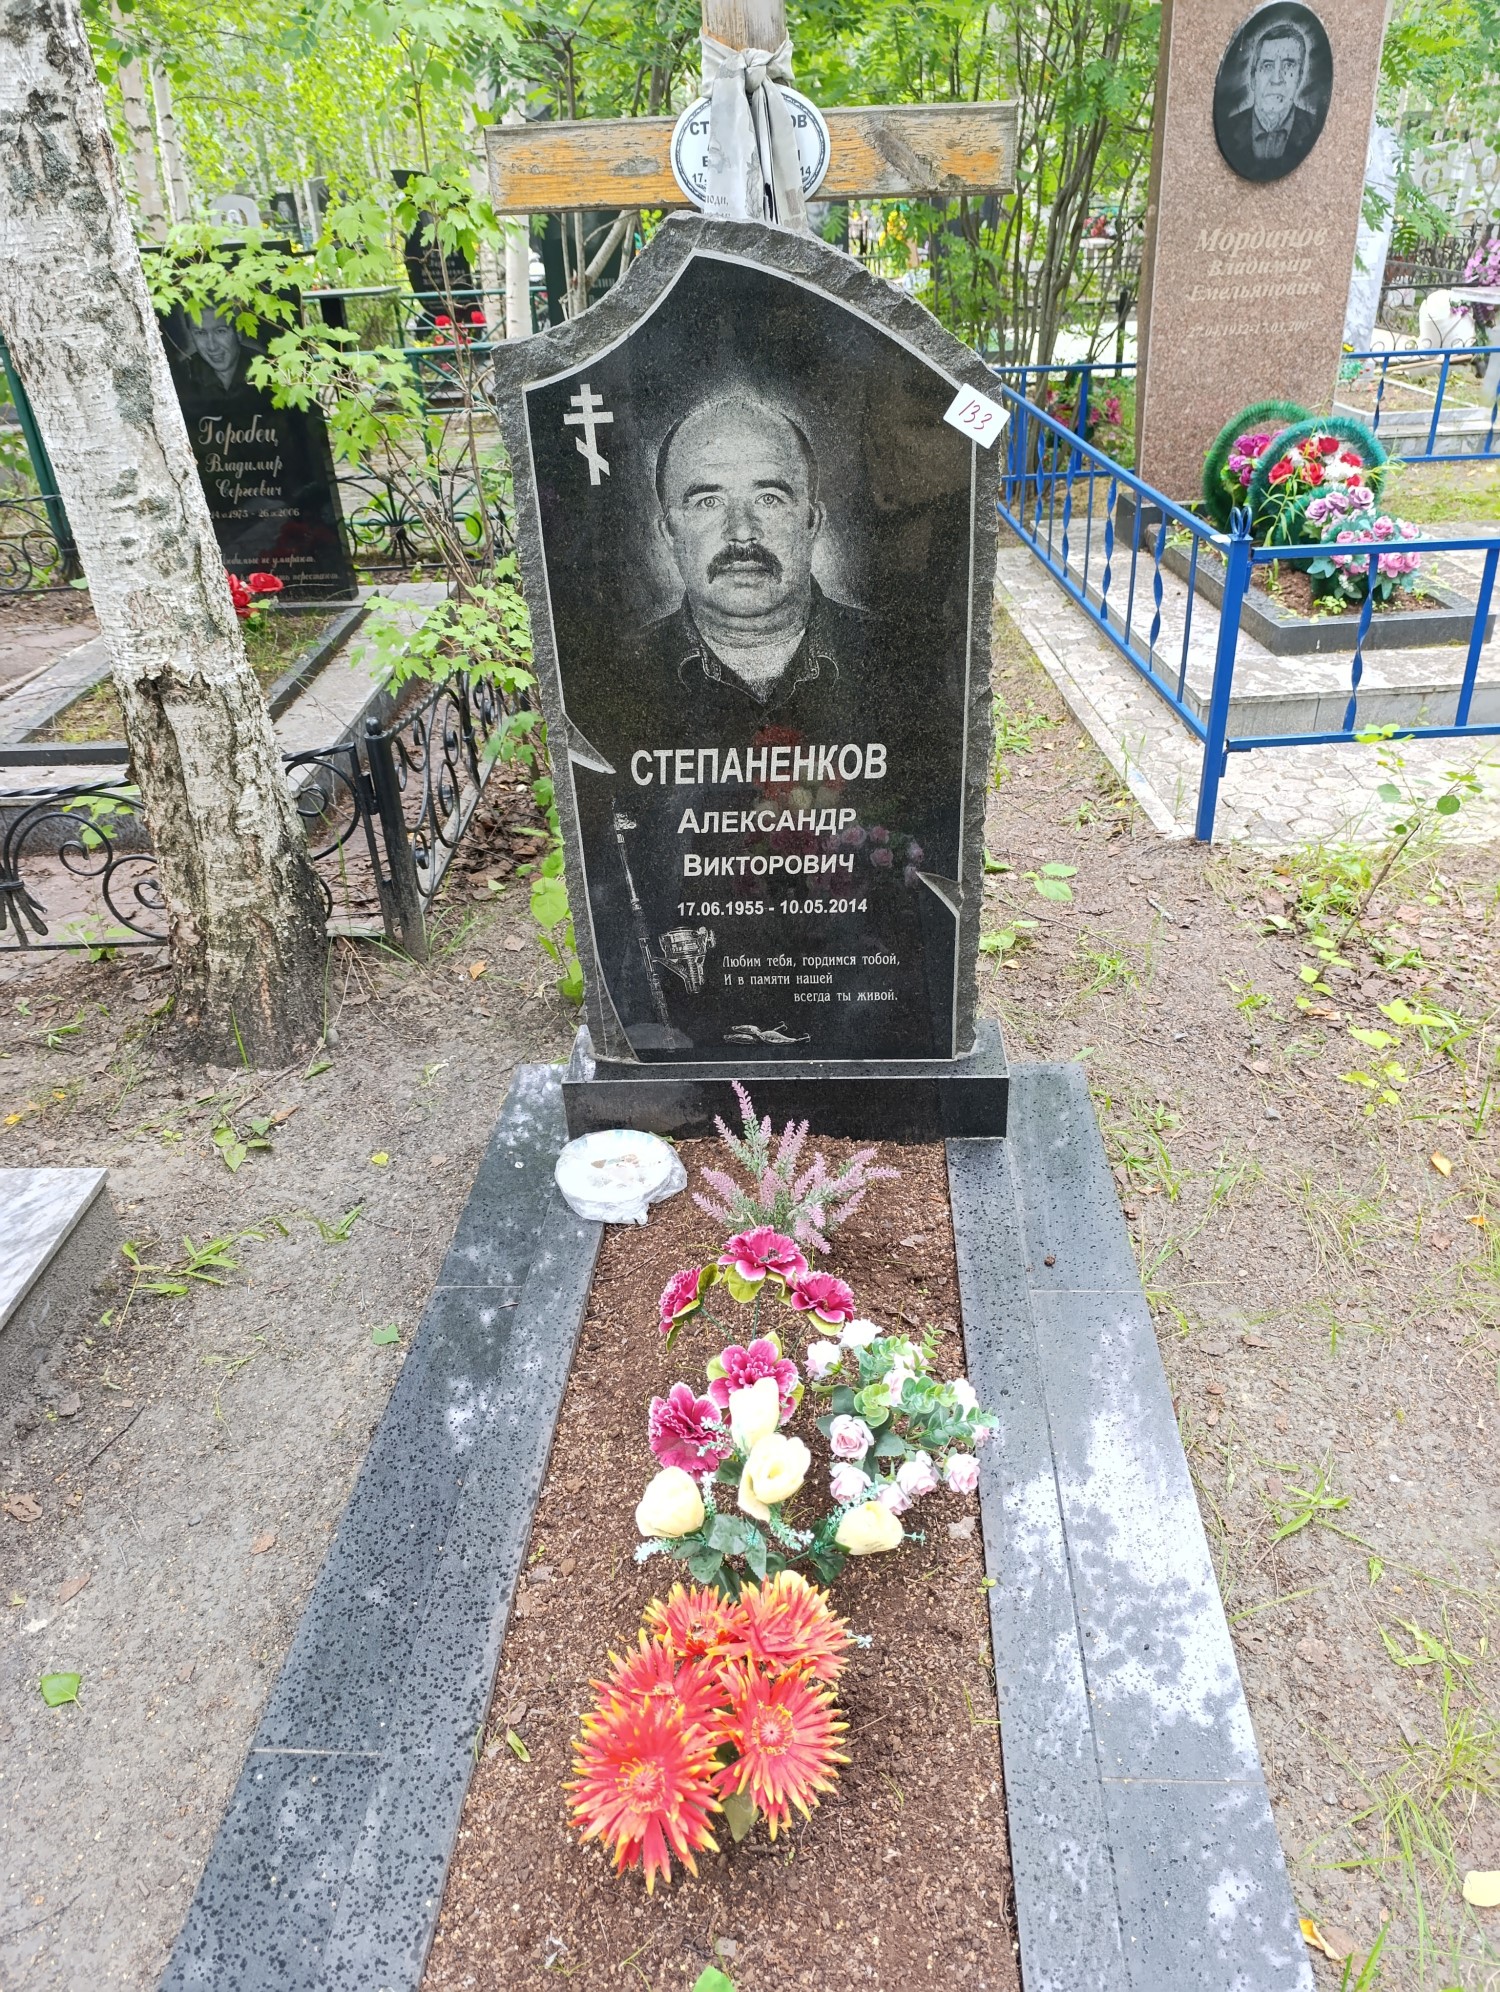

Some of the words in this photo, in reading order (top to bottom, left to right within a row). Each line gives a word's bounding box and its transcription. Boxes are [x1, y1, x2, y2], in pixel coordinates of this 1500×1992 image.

[1194, 225, 1328, 257] Мординов
[1208, 255, 1312, 277] Владимир
[1188, 281, 1323, 301] Емельянович
[959, 400, 992, 430] 133
[198, 414, 279, 455] Горобец
[205, 453, 283, 479] Владимир
[215, 479, 282, 505] Сергеевич
[630, 743, 887, 786] СТЕПАНЕНКОВ
[677, 900, 764, 917] 17.06.1955
[780, 898, 868, 915] 10.05.2014
[722, 954, 761, 968] Любим
[766, 953, 796, 968] тебя,
[802, 955, 857, 969] гордимся
[862, 951, 900, 966] тобой,
[724, 973, 732, 986] И
[738, 976, 745, 985] в
[750, 974, 790, 985] памяти
[796, 972, 833, 985] нашей
[794, 992, 831, 1003] всегда
[836, 992, 851, 1002] ты
[856, 989, 898, 1002] живой.
